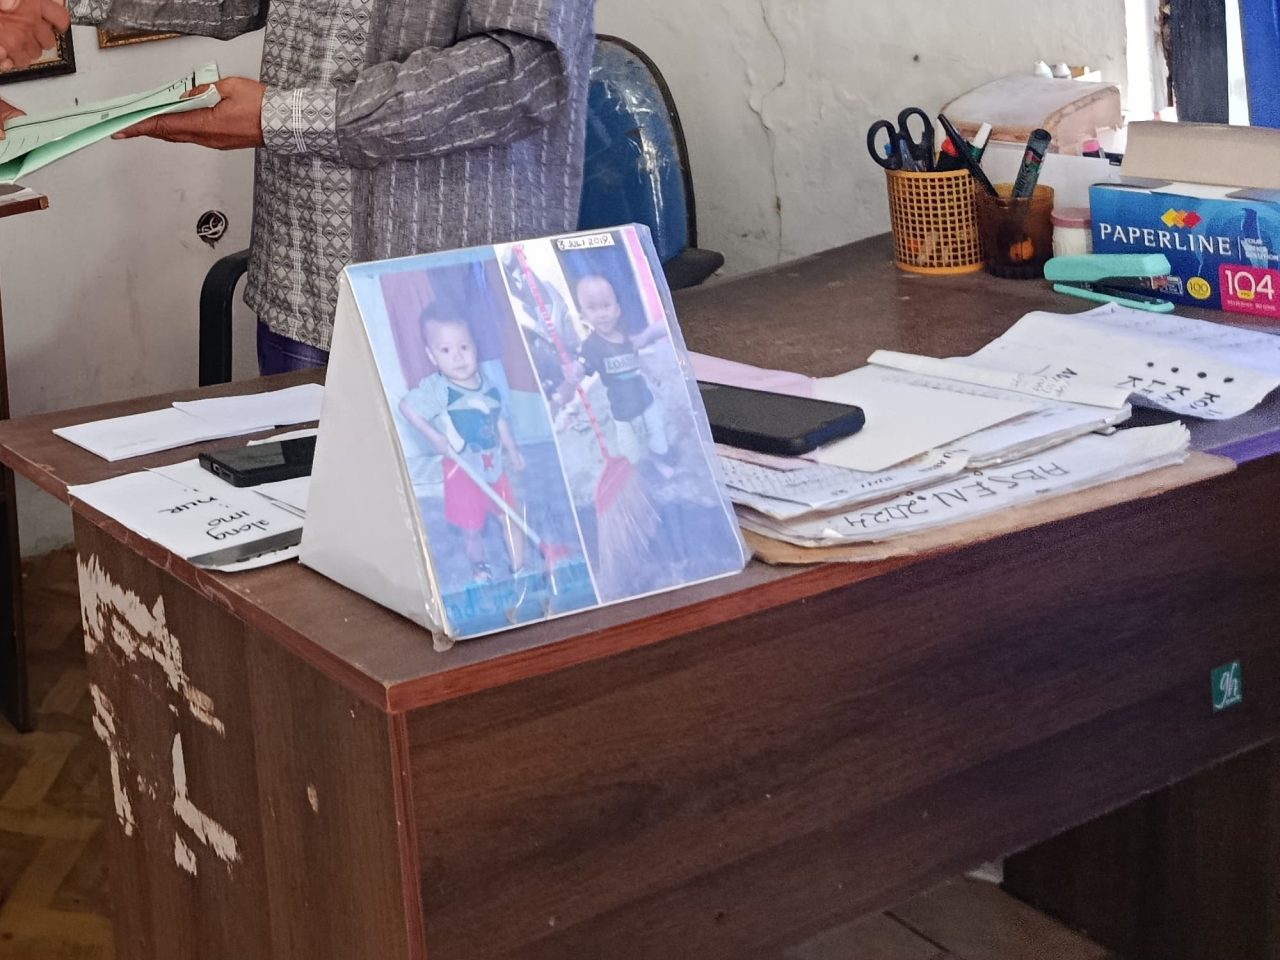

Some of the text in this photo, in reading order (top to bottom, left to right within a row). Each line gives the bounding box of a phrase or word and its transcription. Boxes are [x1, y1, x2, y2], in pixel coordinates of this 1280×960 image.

[568, 239, 586, 248] JULI
[1100, 223, 1232, 255] PAPERLINE
[1189, 282, 1208, 292] 100
[1224, 270, 1275, 300] 104
